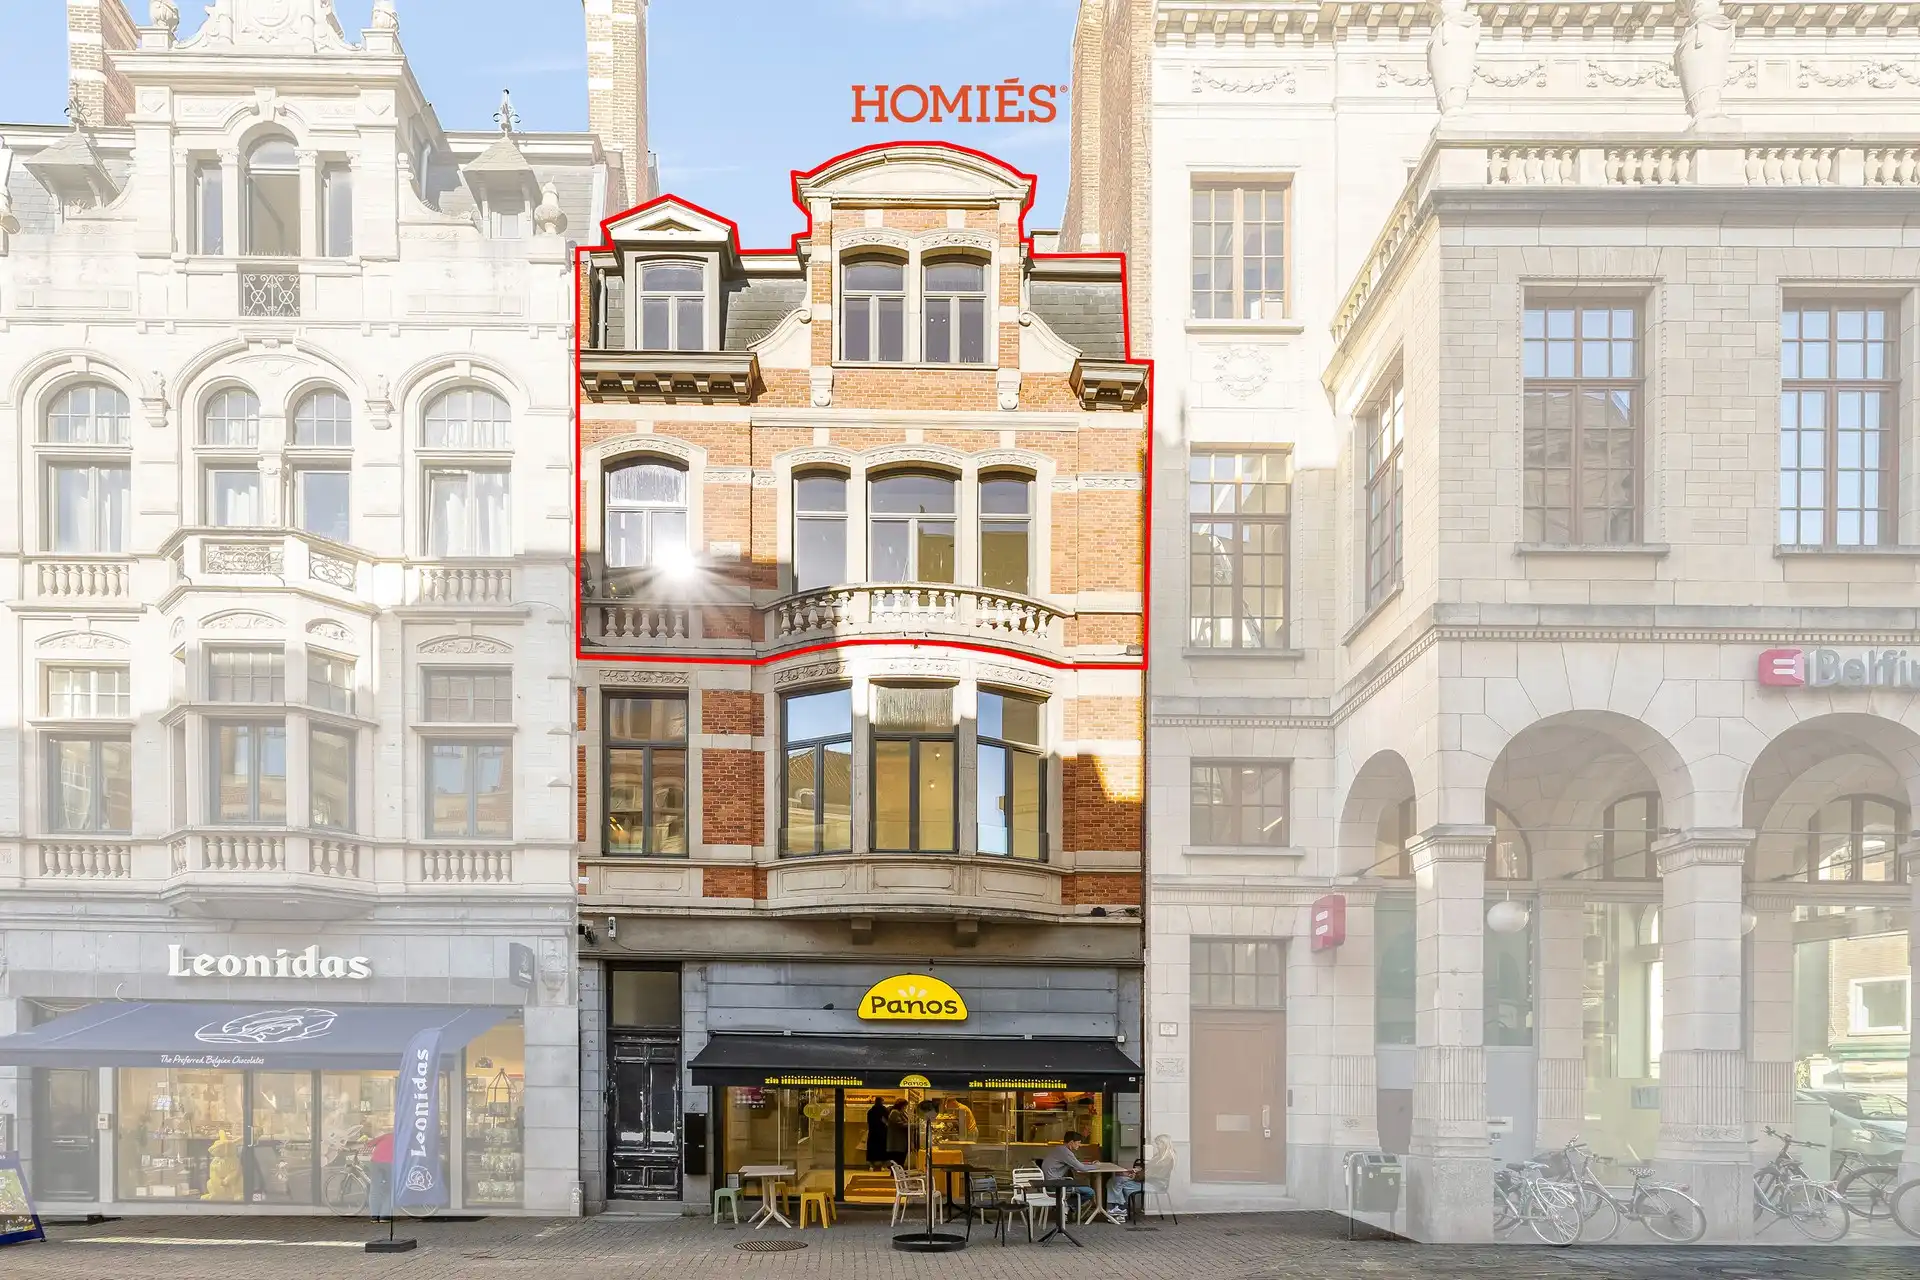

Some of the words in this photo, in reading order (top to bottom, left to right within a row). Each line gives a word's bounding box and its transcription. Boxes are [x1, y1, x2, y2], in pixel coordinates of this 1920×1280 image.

[168, 944, 373, 979] Leonidas
[871, 995, 958, 1015] Panos
[160, 1054, 172, 1064] The
[172, 1054, 205, 1066] Preferred
[205, 1055, 231, 1068] Belgian
[232, 1055, 265, 1065] Chocolates
[411, 1048, 429, 1158] Leonidas
